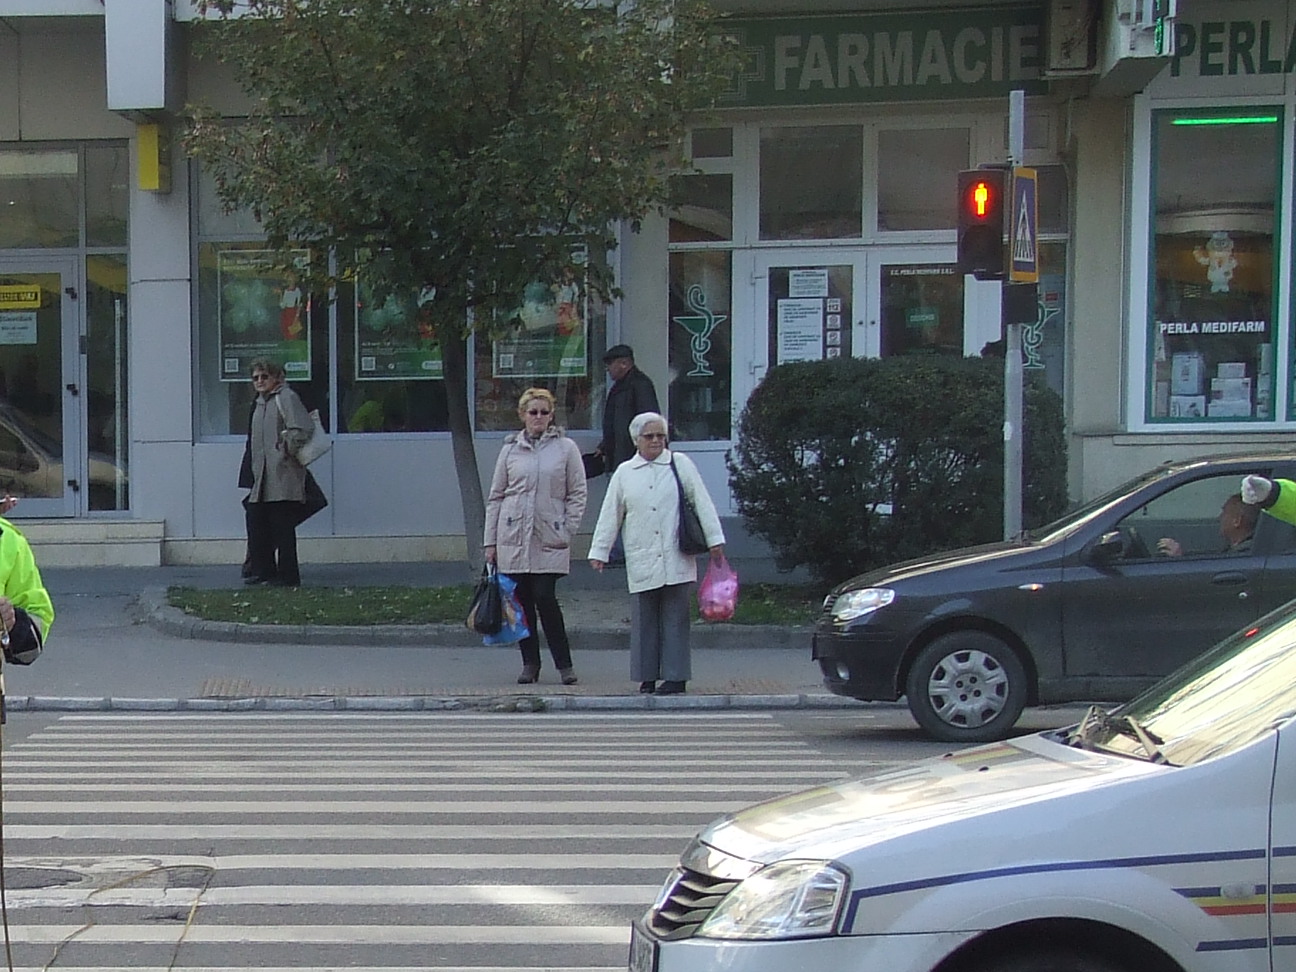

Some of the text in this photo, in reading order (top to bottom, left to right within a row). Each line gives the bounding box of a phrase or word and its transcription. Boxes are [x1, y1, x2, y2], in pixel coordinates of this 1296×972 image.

[774, 25, 1040, 91] FARMACIE
[1160, 321, 1265, 334] PERLA MEDIFARM
